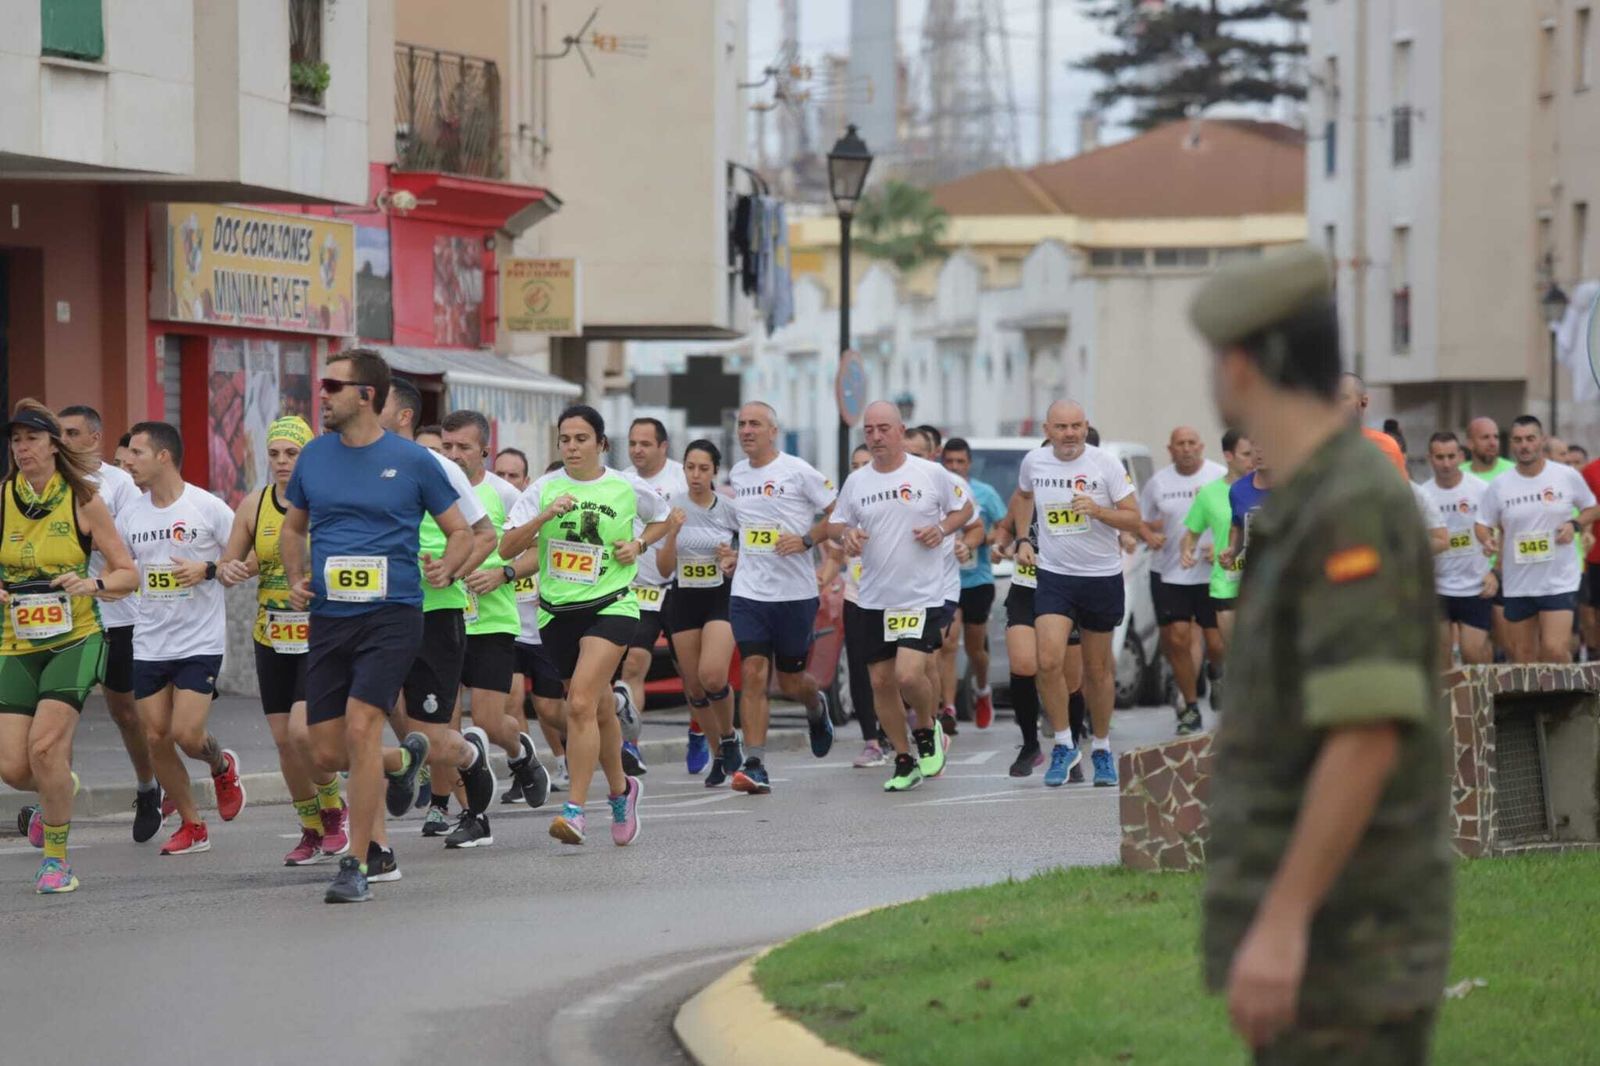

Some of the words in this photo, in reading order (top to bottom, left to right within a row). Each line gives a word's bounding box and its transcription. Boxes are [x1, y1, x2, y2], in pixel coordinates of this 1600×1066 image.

[213, 216, 241, 252] DOS
[241, 221, 313, 262] CORAZONES
[213, 269, 310, 319] MINIMARKET
[750, 531, 772, 545] 73
[1450, 535, 1470, 548] 62
[1519, 540, 1548, 553] 346
[553, 552, 593, 572] 172
[683, 564, 717, 577] 393
[148, 573, 180, 588] 35
[339, 570, 369, 587] 69
[514, 577, 534, 592] 24
[632, 588, 660, 602] 10
[17, 606, 63, 625] 249
[887, 616, 919, 630] 210
[270, 623, 310, 640] 219
